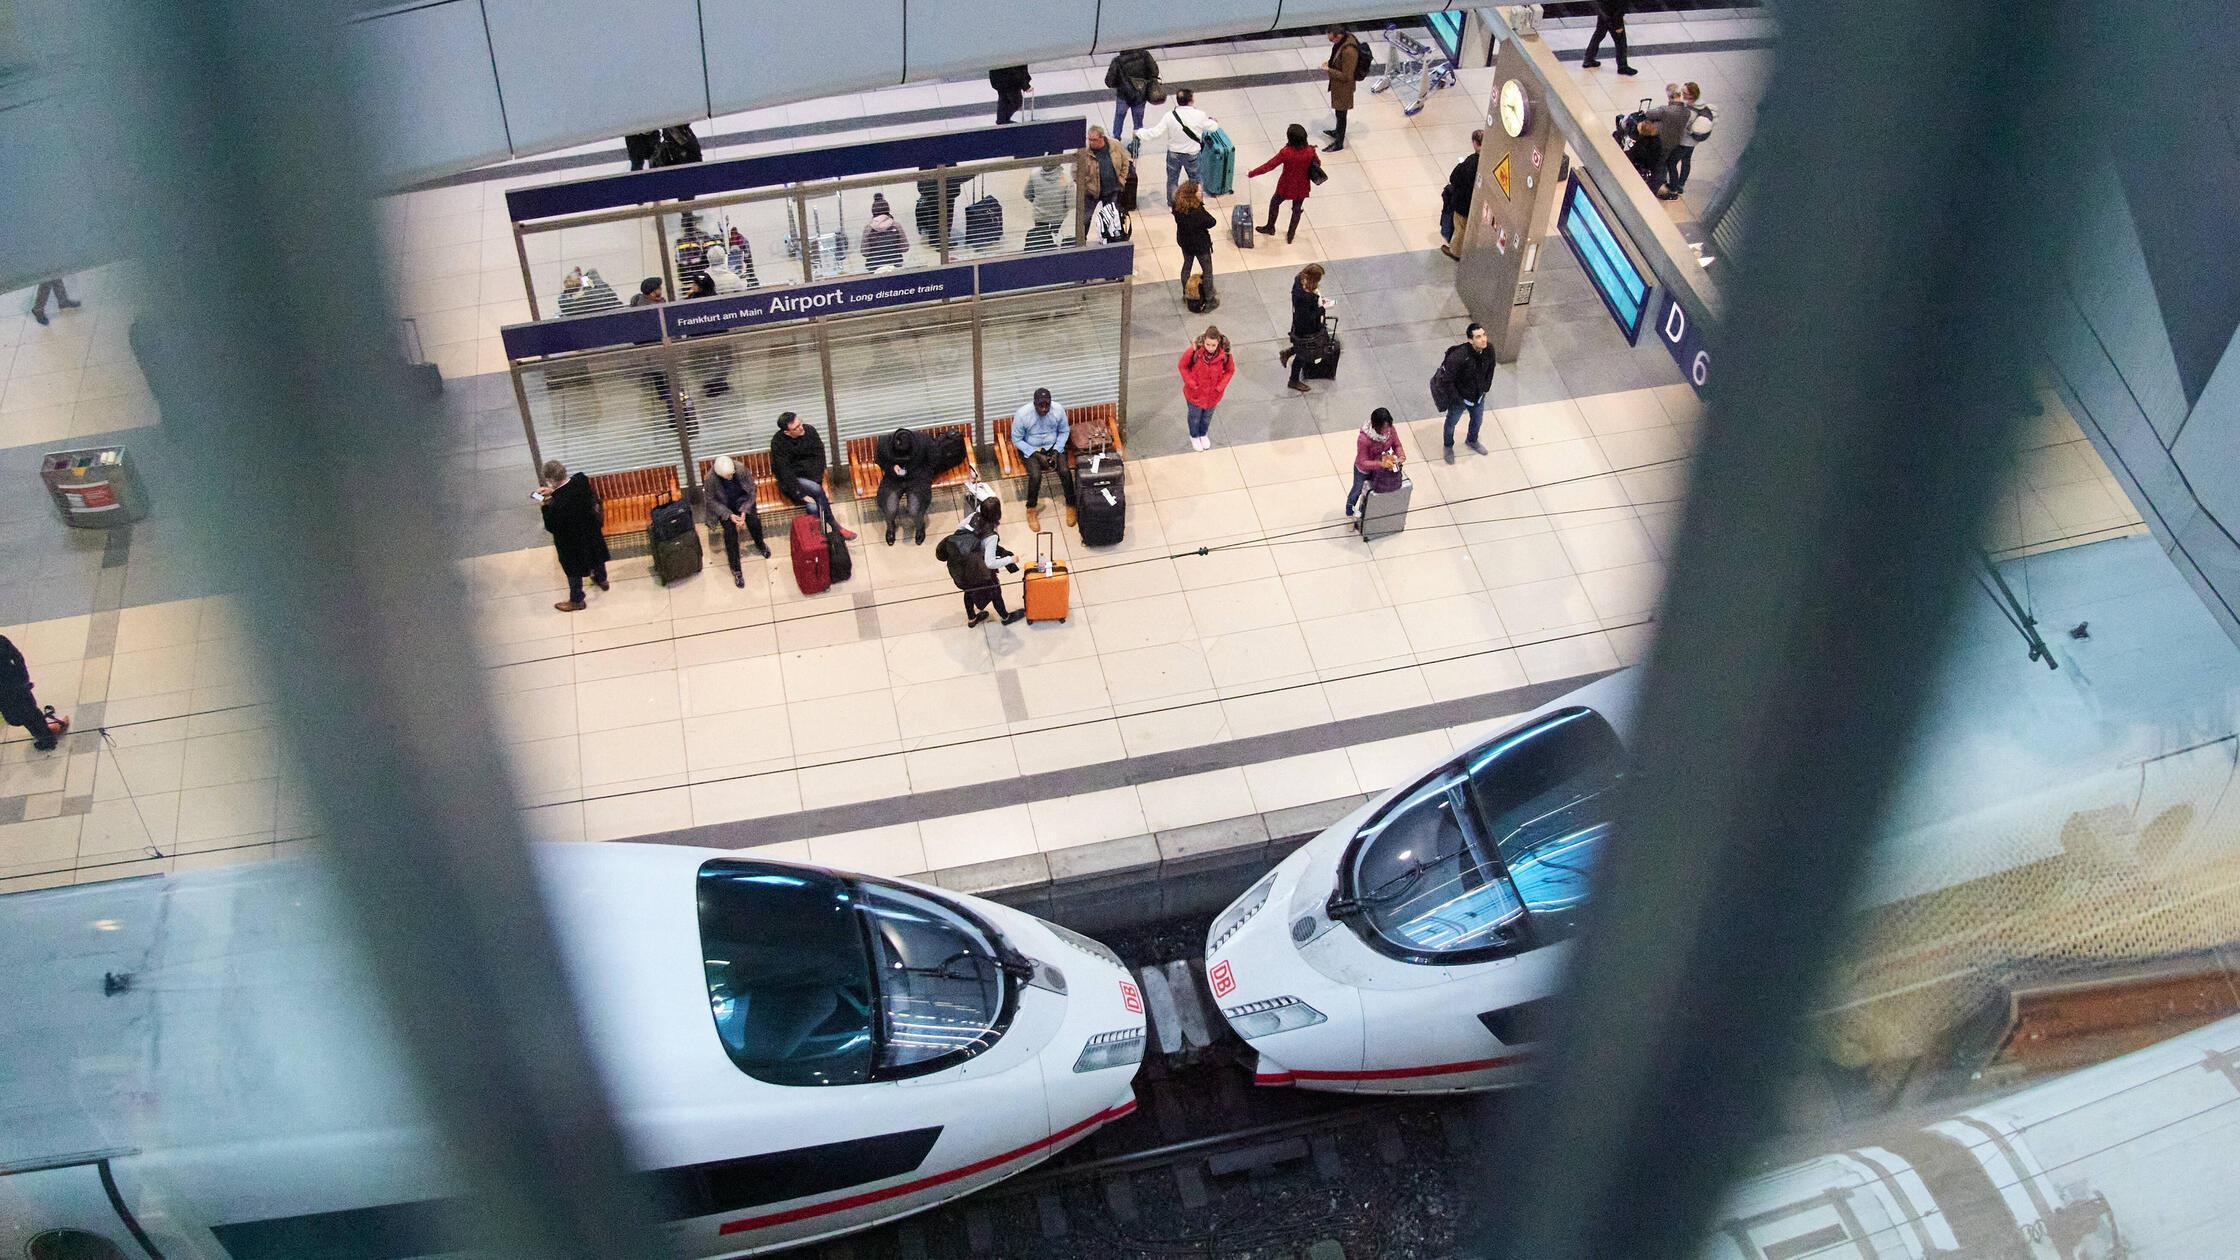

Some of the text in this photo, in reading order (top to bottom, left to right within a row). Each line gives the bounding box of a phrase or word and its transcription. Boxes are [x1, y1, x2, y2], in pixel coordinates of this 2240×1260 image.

[677, 282, 944, 327] Frankfurt am Main Airport Long distance trains
[1665, 301, 1711, 386] D 6
[1212, 964, 1232, 993] DB
[1123, 985, 1140, 1011] DB
